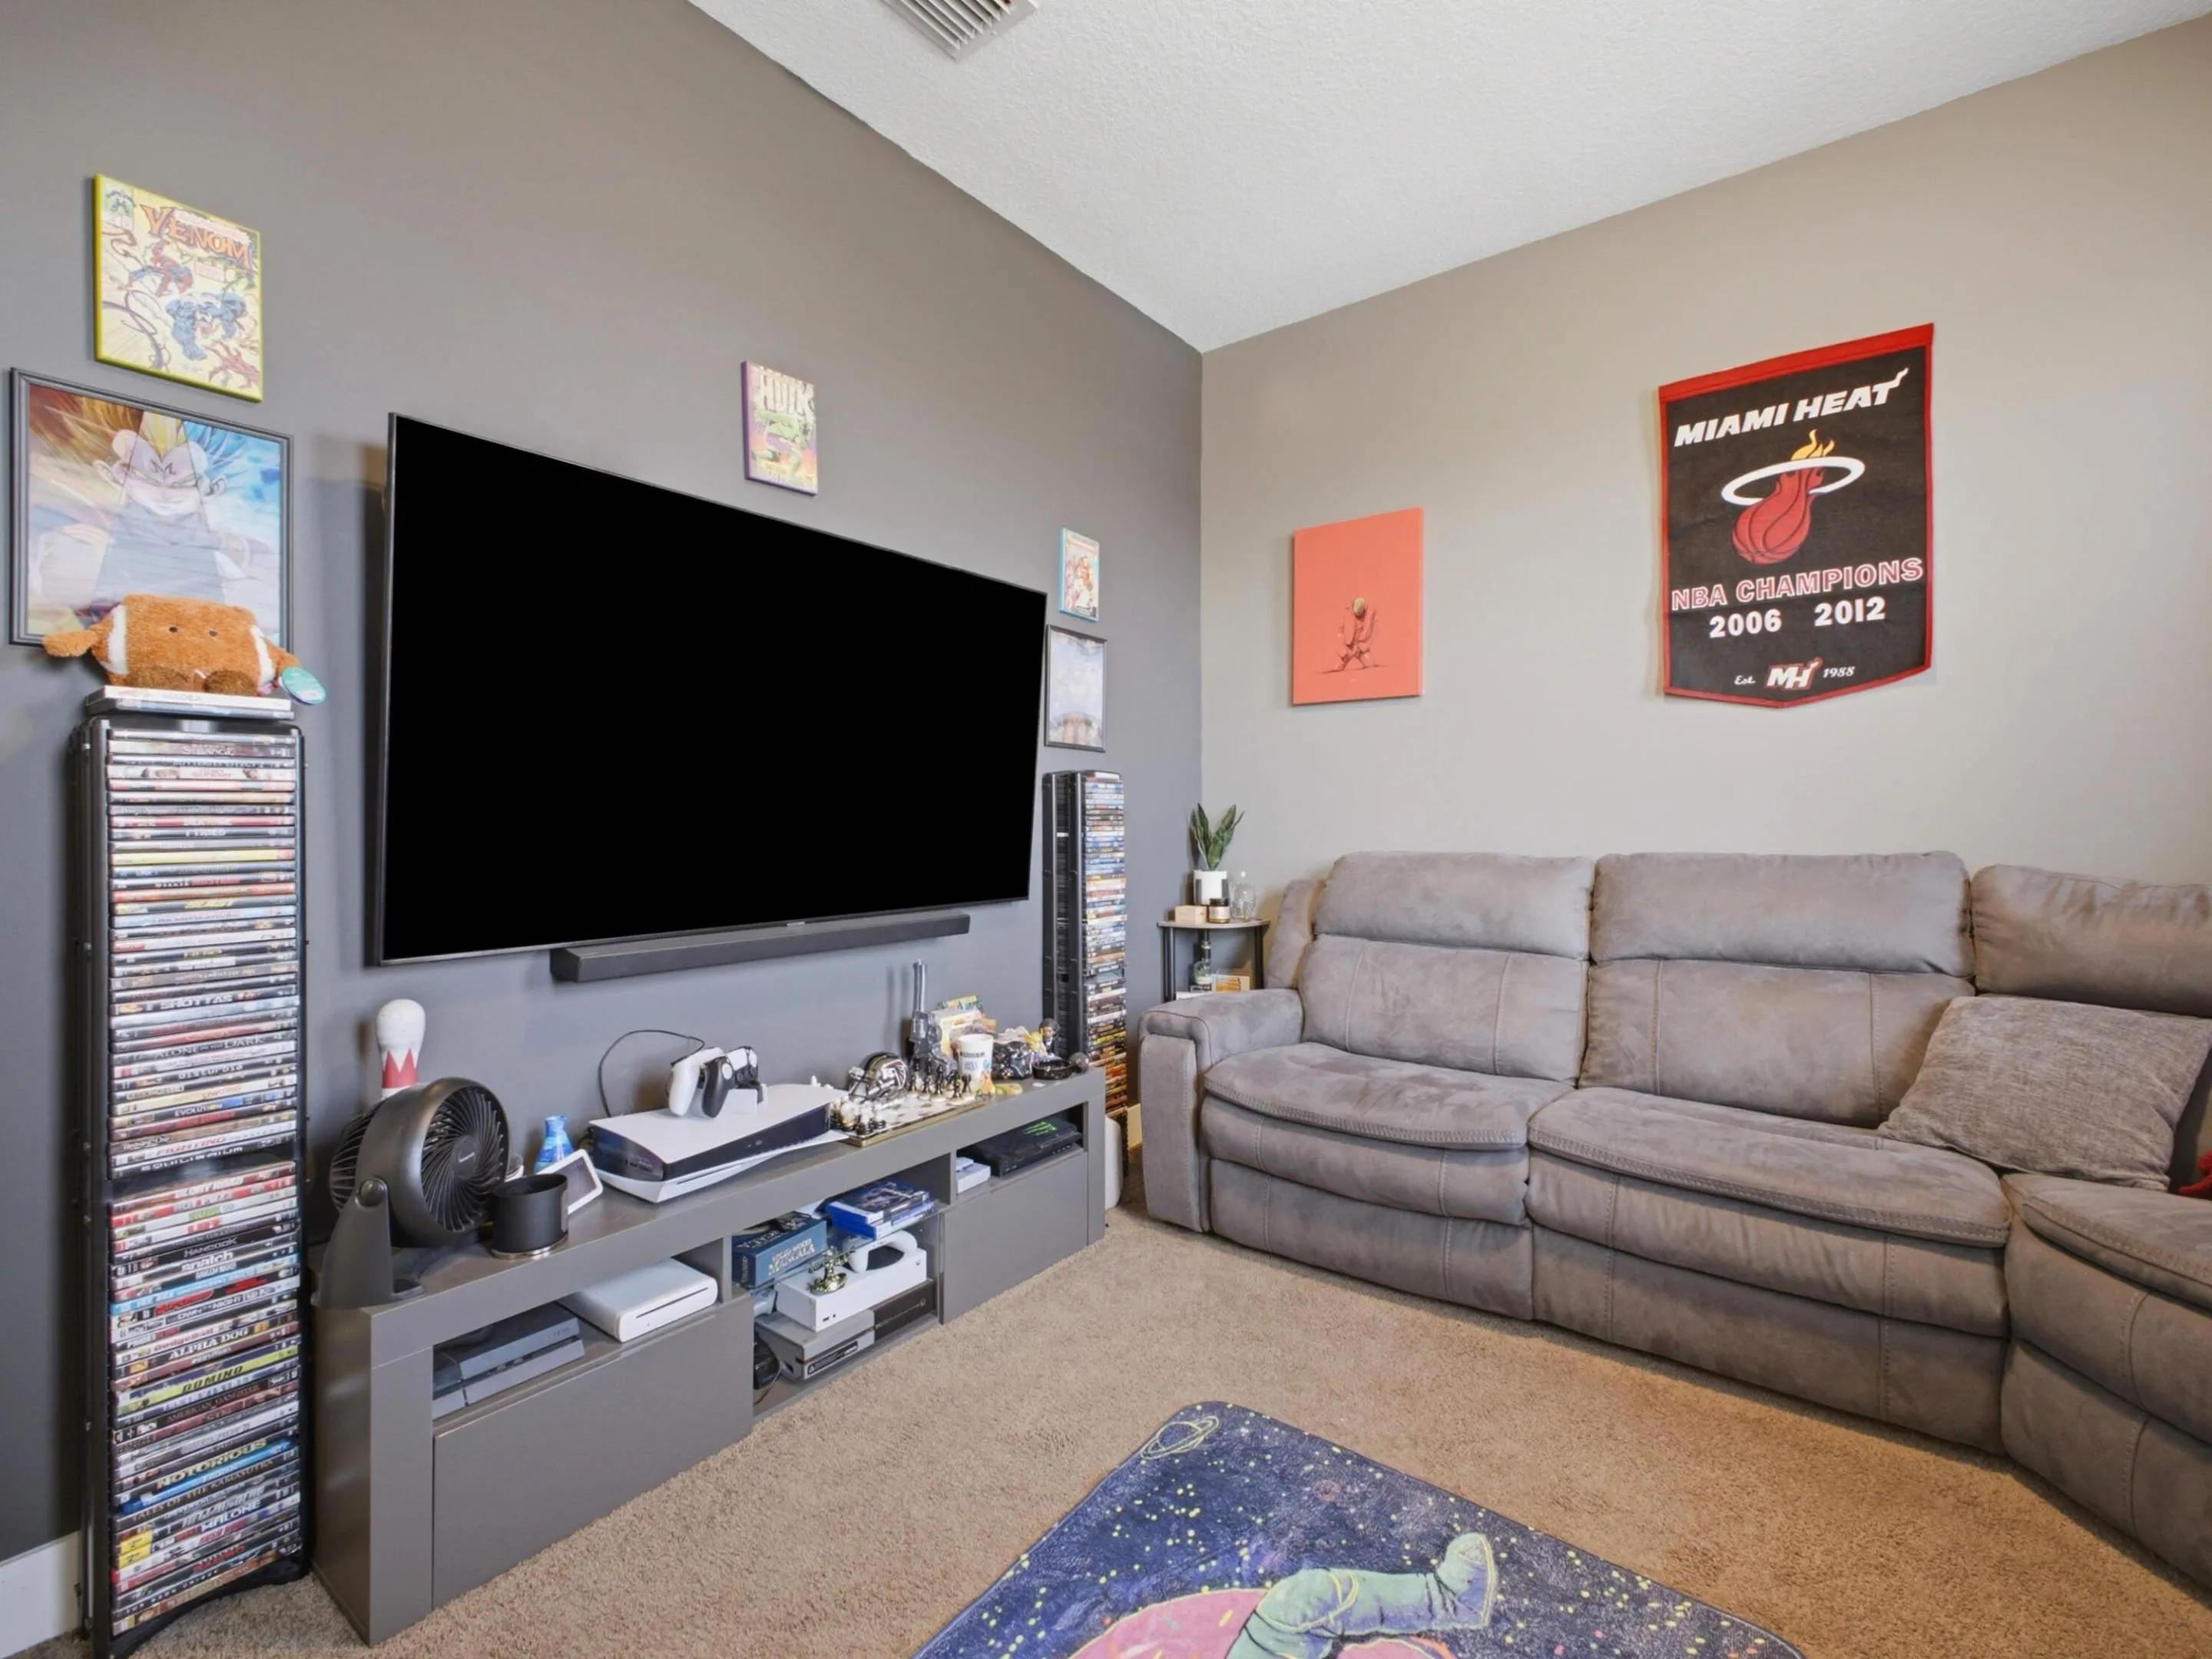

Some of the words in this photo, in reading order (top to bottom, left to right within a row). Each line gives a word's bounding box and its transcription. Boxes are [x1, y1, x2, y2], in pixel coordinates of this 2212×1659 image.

[139, 204, 252, 270] VENOM
[1674, 402, 1788, 446] MIAMI
[1793, 368, 1909, 422] HEAT
[1671, 583, 1727, 611] NBA
[1735, 558, 1923, 603] CHAMPIONS
[1709, 609, 1783, 637] 2006
[1813, 597, 1886, 627] 2012
[1823, 666, 1856, 678] 1988
[160, 994, 233, 1009] SHOTTAS
[224, 1038, 265, 1049] DARK
[184, 1237, 237, 1258] HANCOCK
[181, 1250, 233, 1272] snatch
[169, 1336, 218, 1360] ALPHA
[221, 1328, 249, 1343] DOG
[182, 1366, 243, 1392] DOMINO
[167, 1402, 212, 1421] AMERICAN
[156, 1439, 267, 1490] NOTORIOUS
[132, 1505, 164, 1521] TALES
[201, 1499, 260, 1532] MALONE
